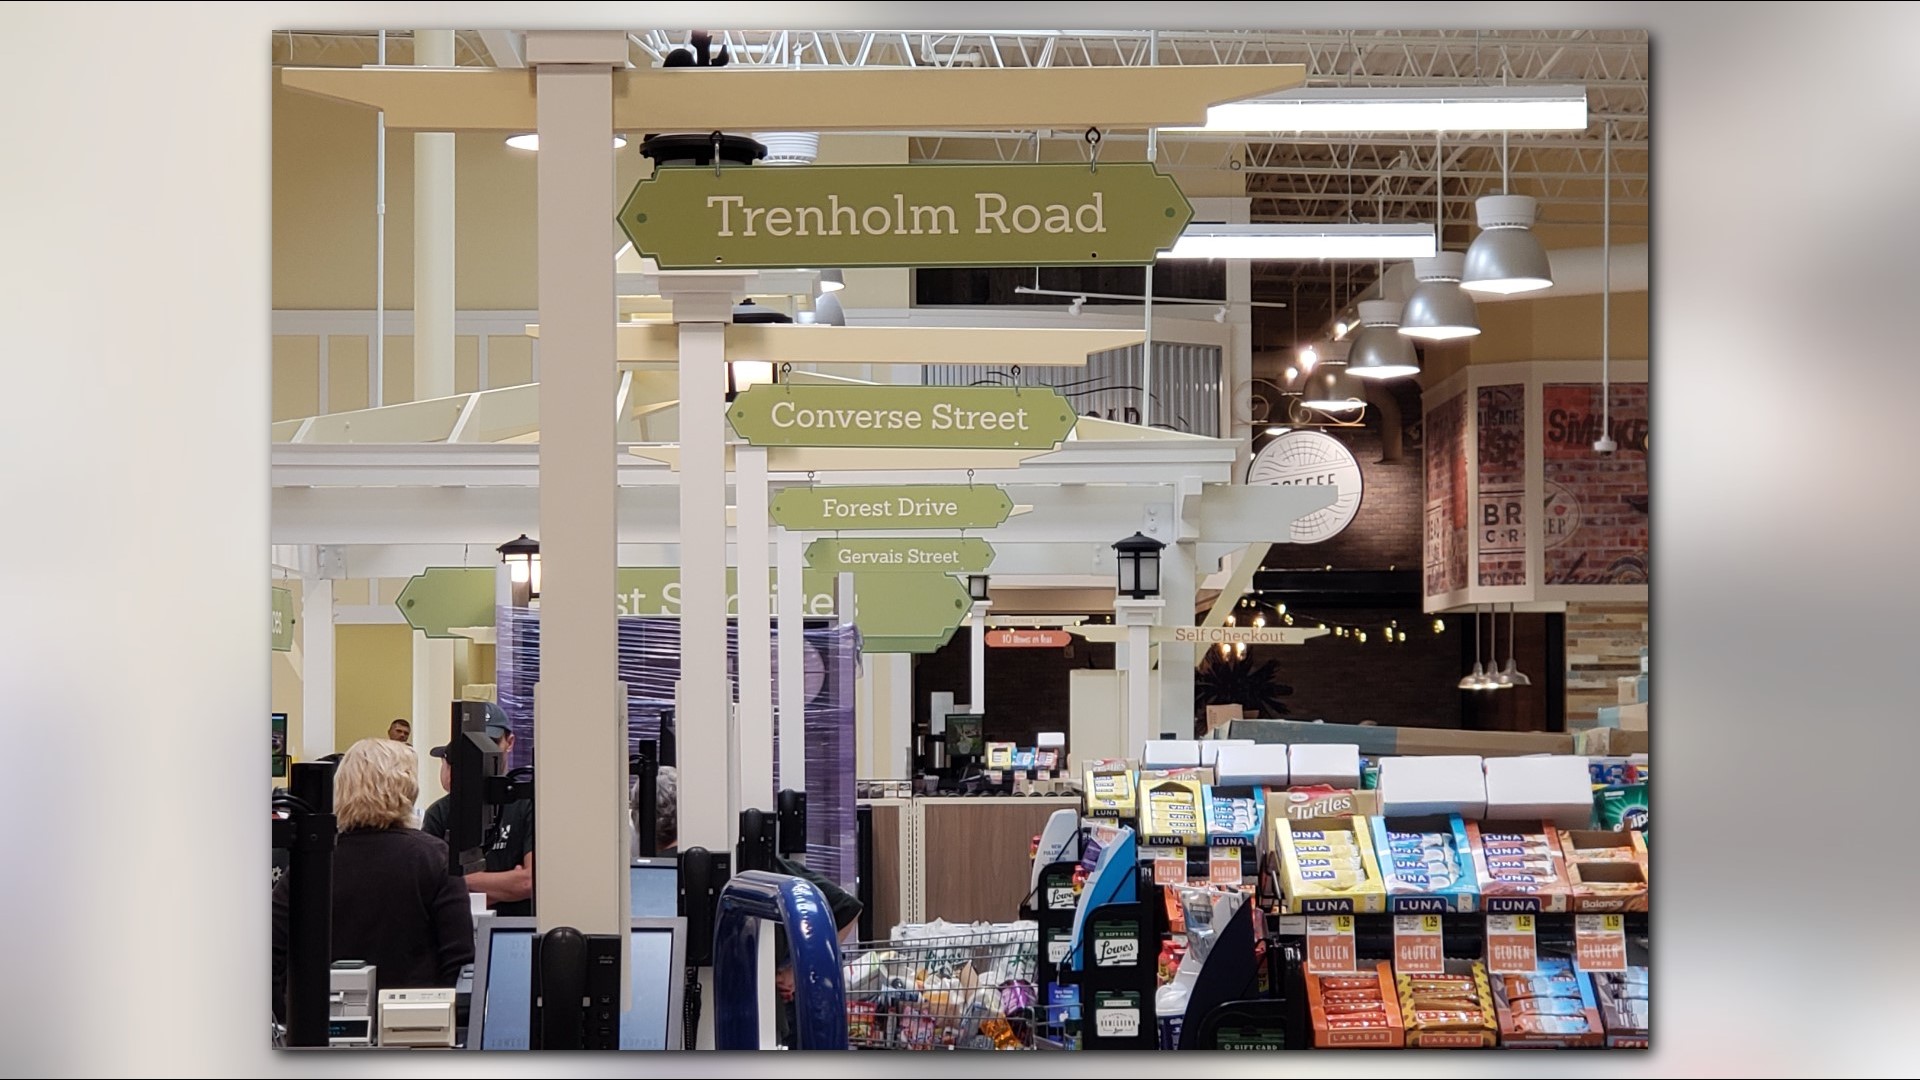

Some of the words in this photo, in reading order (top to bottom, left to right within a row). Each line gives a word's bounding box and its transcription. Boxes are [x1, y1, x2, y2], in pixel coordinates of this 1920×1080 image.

[707, 194, 959, 237] Trenholm
[974, 192, 1107, 234] Road
[770, 401, 922, 431] Converse
[931, 404, 1029, 431] Street
[822, 499, 892, 518] Forest
[898, 497, 959, 517] Drive
[838, 549, 903, 564] Gervais
[907, 549, 960, 564] Street
[1175, 628, 1206, 642] Self
[1210, 628, 1286, 642] Checkout
[1287, 797, 1351, 819] Turtles
[1049, 889, 1073, 906] Lowe
[1582, 900, 1623, 909] Balance
[1307, 901, 1350, 912] LUNA
[1400, 900, 1443, 910] LUNA
[1493, 901, 1536, 911] LUNA
[1097, 940, 1134, 964] Lowes
[1314, 946, 1349, 960] GLUTEN
[1401, 946, 1436, 960] GLUTEN
[1495, 946, 1530, 960] GLUTEN
[1583, 944, 1619, 959] GLUTEN
